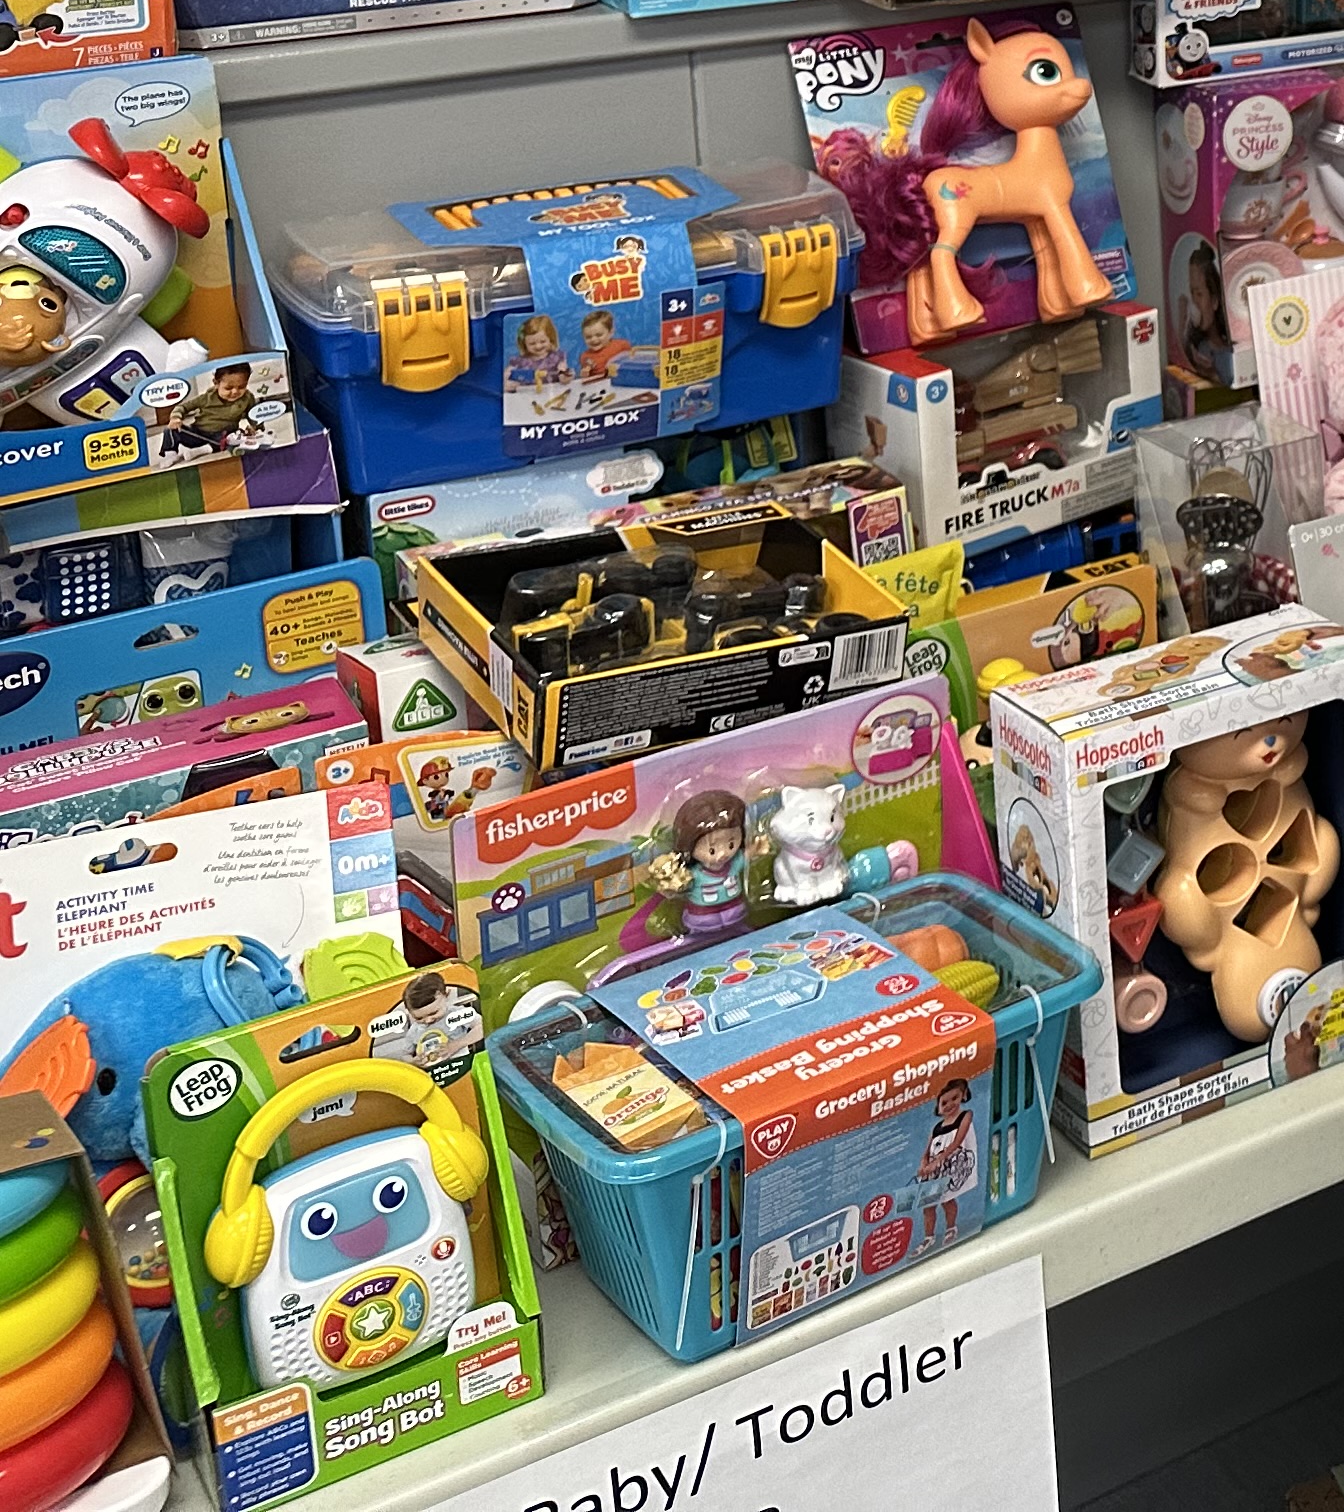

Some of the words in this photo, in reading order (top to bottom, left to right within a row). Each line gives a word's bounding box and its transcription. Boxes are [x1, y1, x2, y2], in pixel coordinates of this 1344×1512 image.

[121, 94, 139, 103] The
[140, 92, 166, 103] plane
[167, 90, 184, 99] has
[121, 103, 139, 112] two
[141, 100, 157, 111] big
[157, 95, 187, 109] wings!
[1232, 123, 1284, 136] PRINCESS
[1236, 136, 1280, 161] Style
[584, 257, 643, 279] BUSY
[592, 277, 641, 303] ME
[520, 424, 547, 440] MY
[549, 418, 600, 437] TOOL
[604, 409, 640, 426] BOX
[89, 434, 133, 454] 9-36
[90, 447, 135, 463] Months
[944, 506, 984, 536] FIRE
[989, 486, 1050, 520] TRUCK
[1050, 479, 1081, 500] M7a
[895, 572, 940, 595] fête
[269, 622, 301, 637] 40+
[294, 628, 343, 648] Teaches
[906, 642, 939, 667] Leap
[518, 685, 529, 740] CAT
[999, 713, 1052, 771] Hopscotch
[1075, 725, 1165, 770] Hopscotch
[487, 787, 630, 845] fisher-price
[337, 850, 391, 876] 0m+
[56, 890, 118, 911] ACTIVITY
[121, 882, 155, 898] TIME
[56, 900, 128, 924] ELEPHANT
[57, 919, 116, 939] L'HEURE
[118, 912, 145, 927] DES
[149, 897, 216, 922] ACTIVITÉS
[58, 938, 77, 951] DE
[80, 920, 163, 947] L'ÉLÉPHANT
[370, 1015, 404, 1034] Hello!
[815, 998, 945, 1053] Shopping
[720, 1050, 816, 1095] Basket
[797, 1034, 903, 1082] Grocery
[175, 1062, 224, 1098] Leap
[184, 1075, 232, 1113] Frog
[814, 1074, 887, 1121] Grocery
[892, 1040, 979, 1088] Shopping
[603, 1084, 669, 1130] Orange
[869, 1080, 931, 1119] Basket
[1111, 1117, 1148, 1136] Trieur
[1150, 1109, 1165, 1121] de
[1167, 1095, 1204, 1115] Forme
[1206, 1086, 1221, 1099] de
[1223, 1075, 1250, 1094] Bain
[1127, 1101, 1156, 1120] Bath
[1157, 1087, 1194, 1108] Shape
[1196, 1072, 1233, 1093] Sorter
[757, 1120, 790, 1147] PLAY
[869, 1197, 887, 1212] 23
[455, 1322, 480, 1340] Try
[483, 1310, 507, 1330] Me!
[506, 1376, 530, 1393] 6+
[324, 1379, 441, 1436] Sing-Along
[323, 1417, 396, 1460] Song
[399, 1398, 445, 1431] Bot
